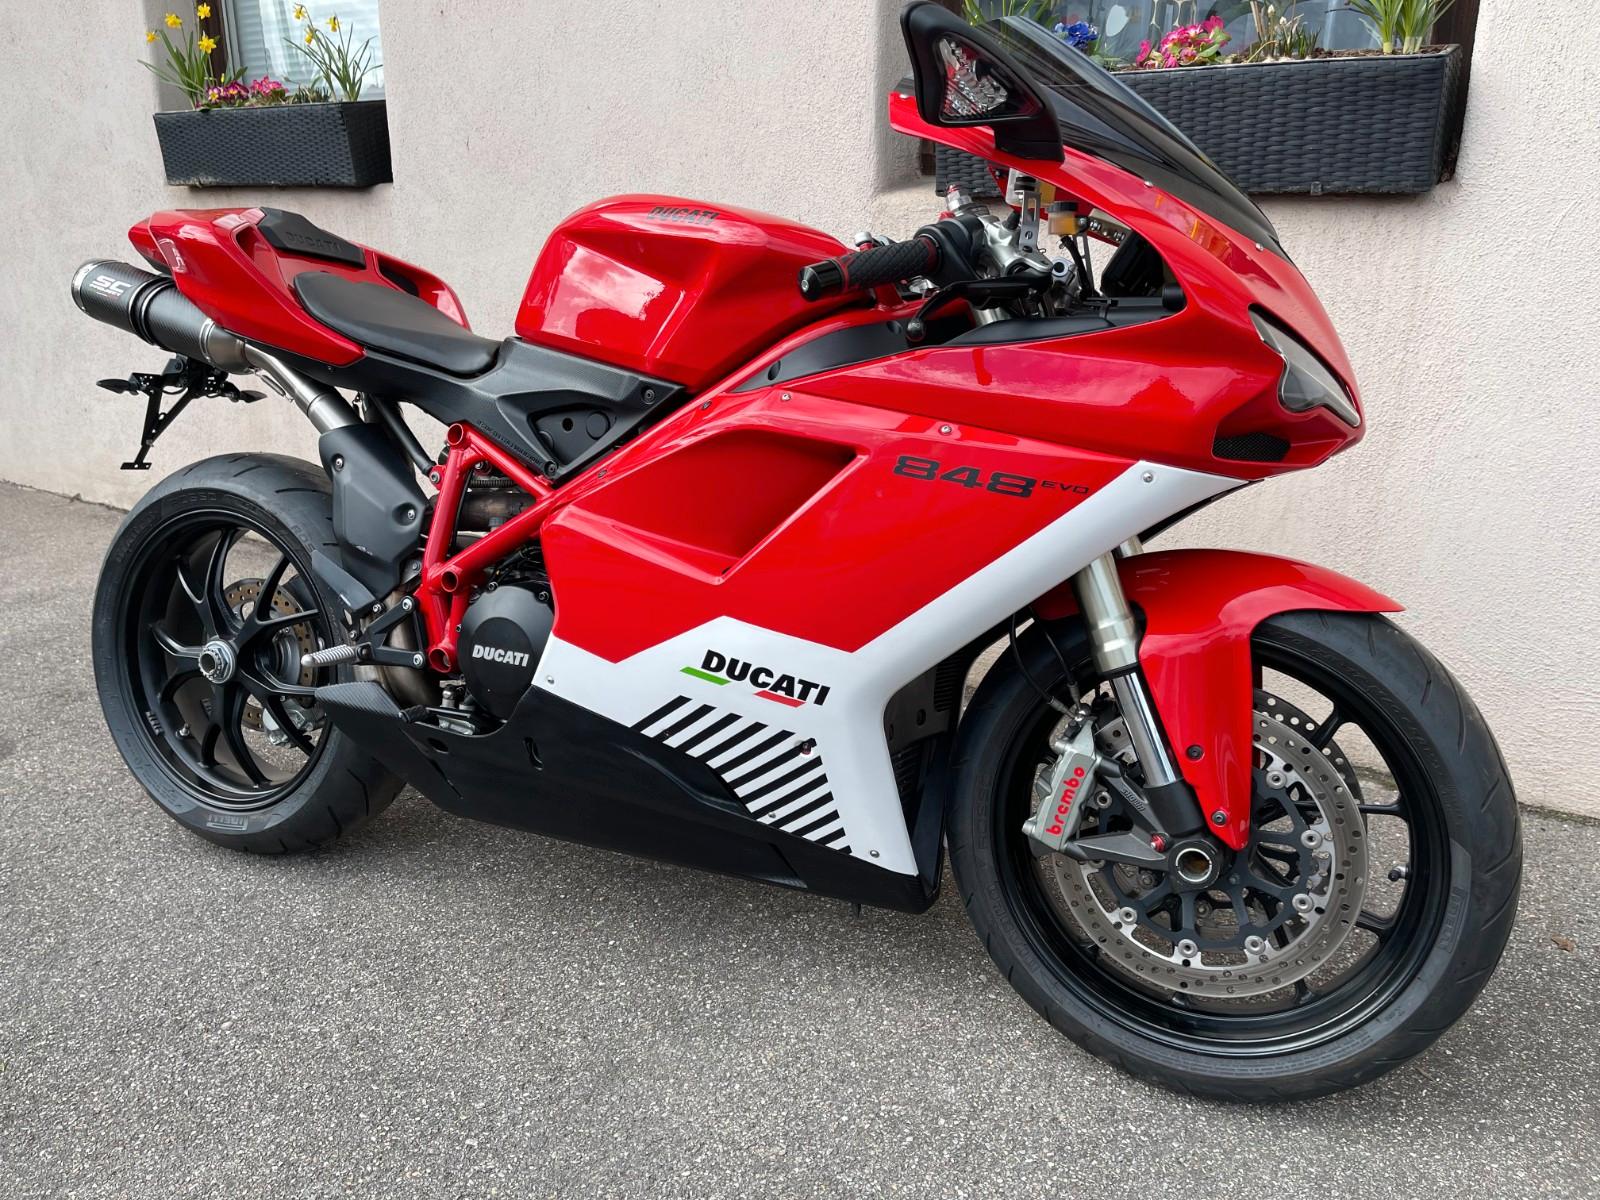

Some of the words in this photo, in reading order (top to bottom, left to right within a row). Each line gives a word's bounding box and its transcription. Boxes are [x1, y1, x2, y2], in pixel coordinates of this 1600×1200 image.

[648, 206, 720, 225] DUCATI
[92, 275, 133, 294] SC
[893, 455, 1036, 499] 848
[1041, 479, 1090, 494] EVO
[472, 644, 530, 667] DUCATI
[701, 649, 831, 706] DUCATI
[1045, 767, 1085, 834] brembo
